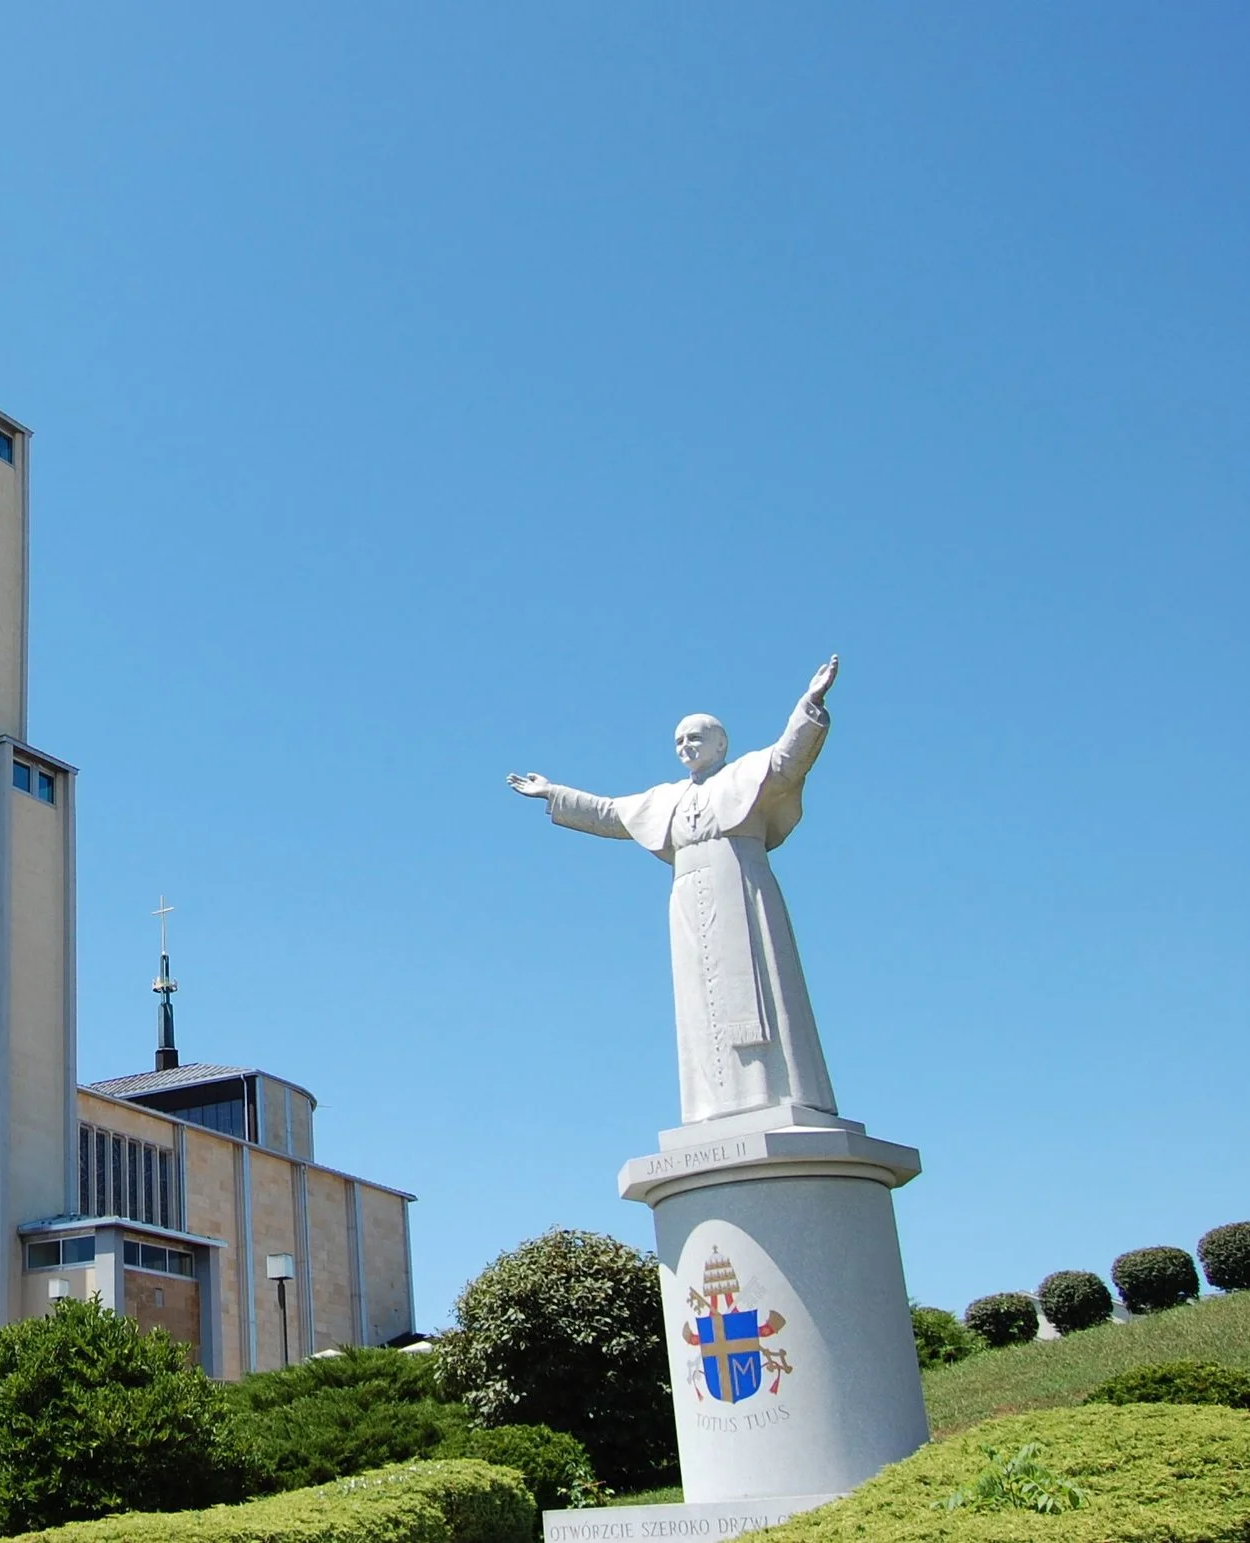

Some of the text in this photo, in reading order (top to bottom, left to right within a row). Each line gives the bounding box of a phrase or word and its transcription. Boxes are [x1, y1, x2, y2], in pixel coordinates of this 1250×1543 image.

[646, 1155, 674, 1175] JAN
[736, 1141, 747, 1157] II
[732, 1356, 757, 1397] M
[695, 1404, 790, 1433] TOTUS TUUS
[641, 1518, 710, 1538] SZEROKO
